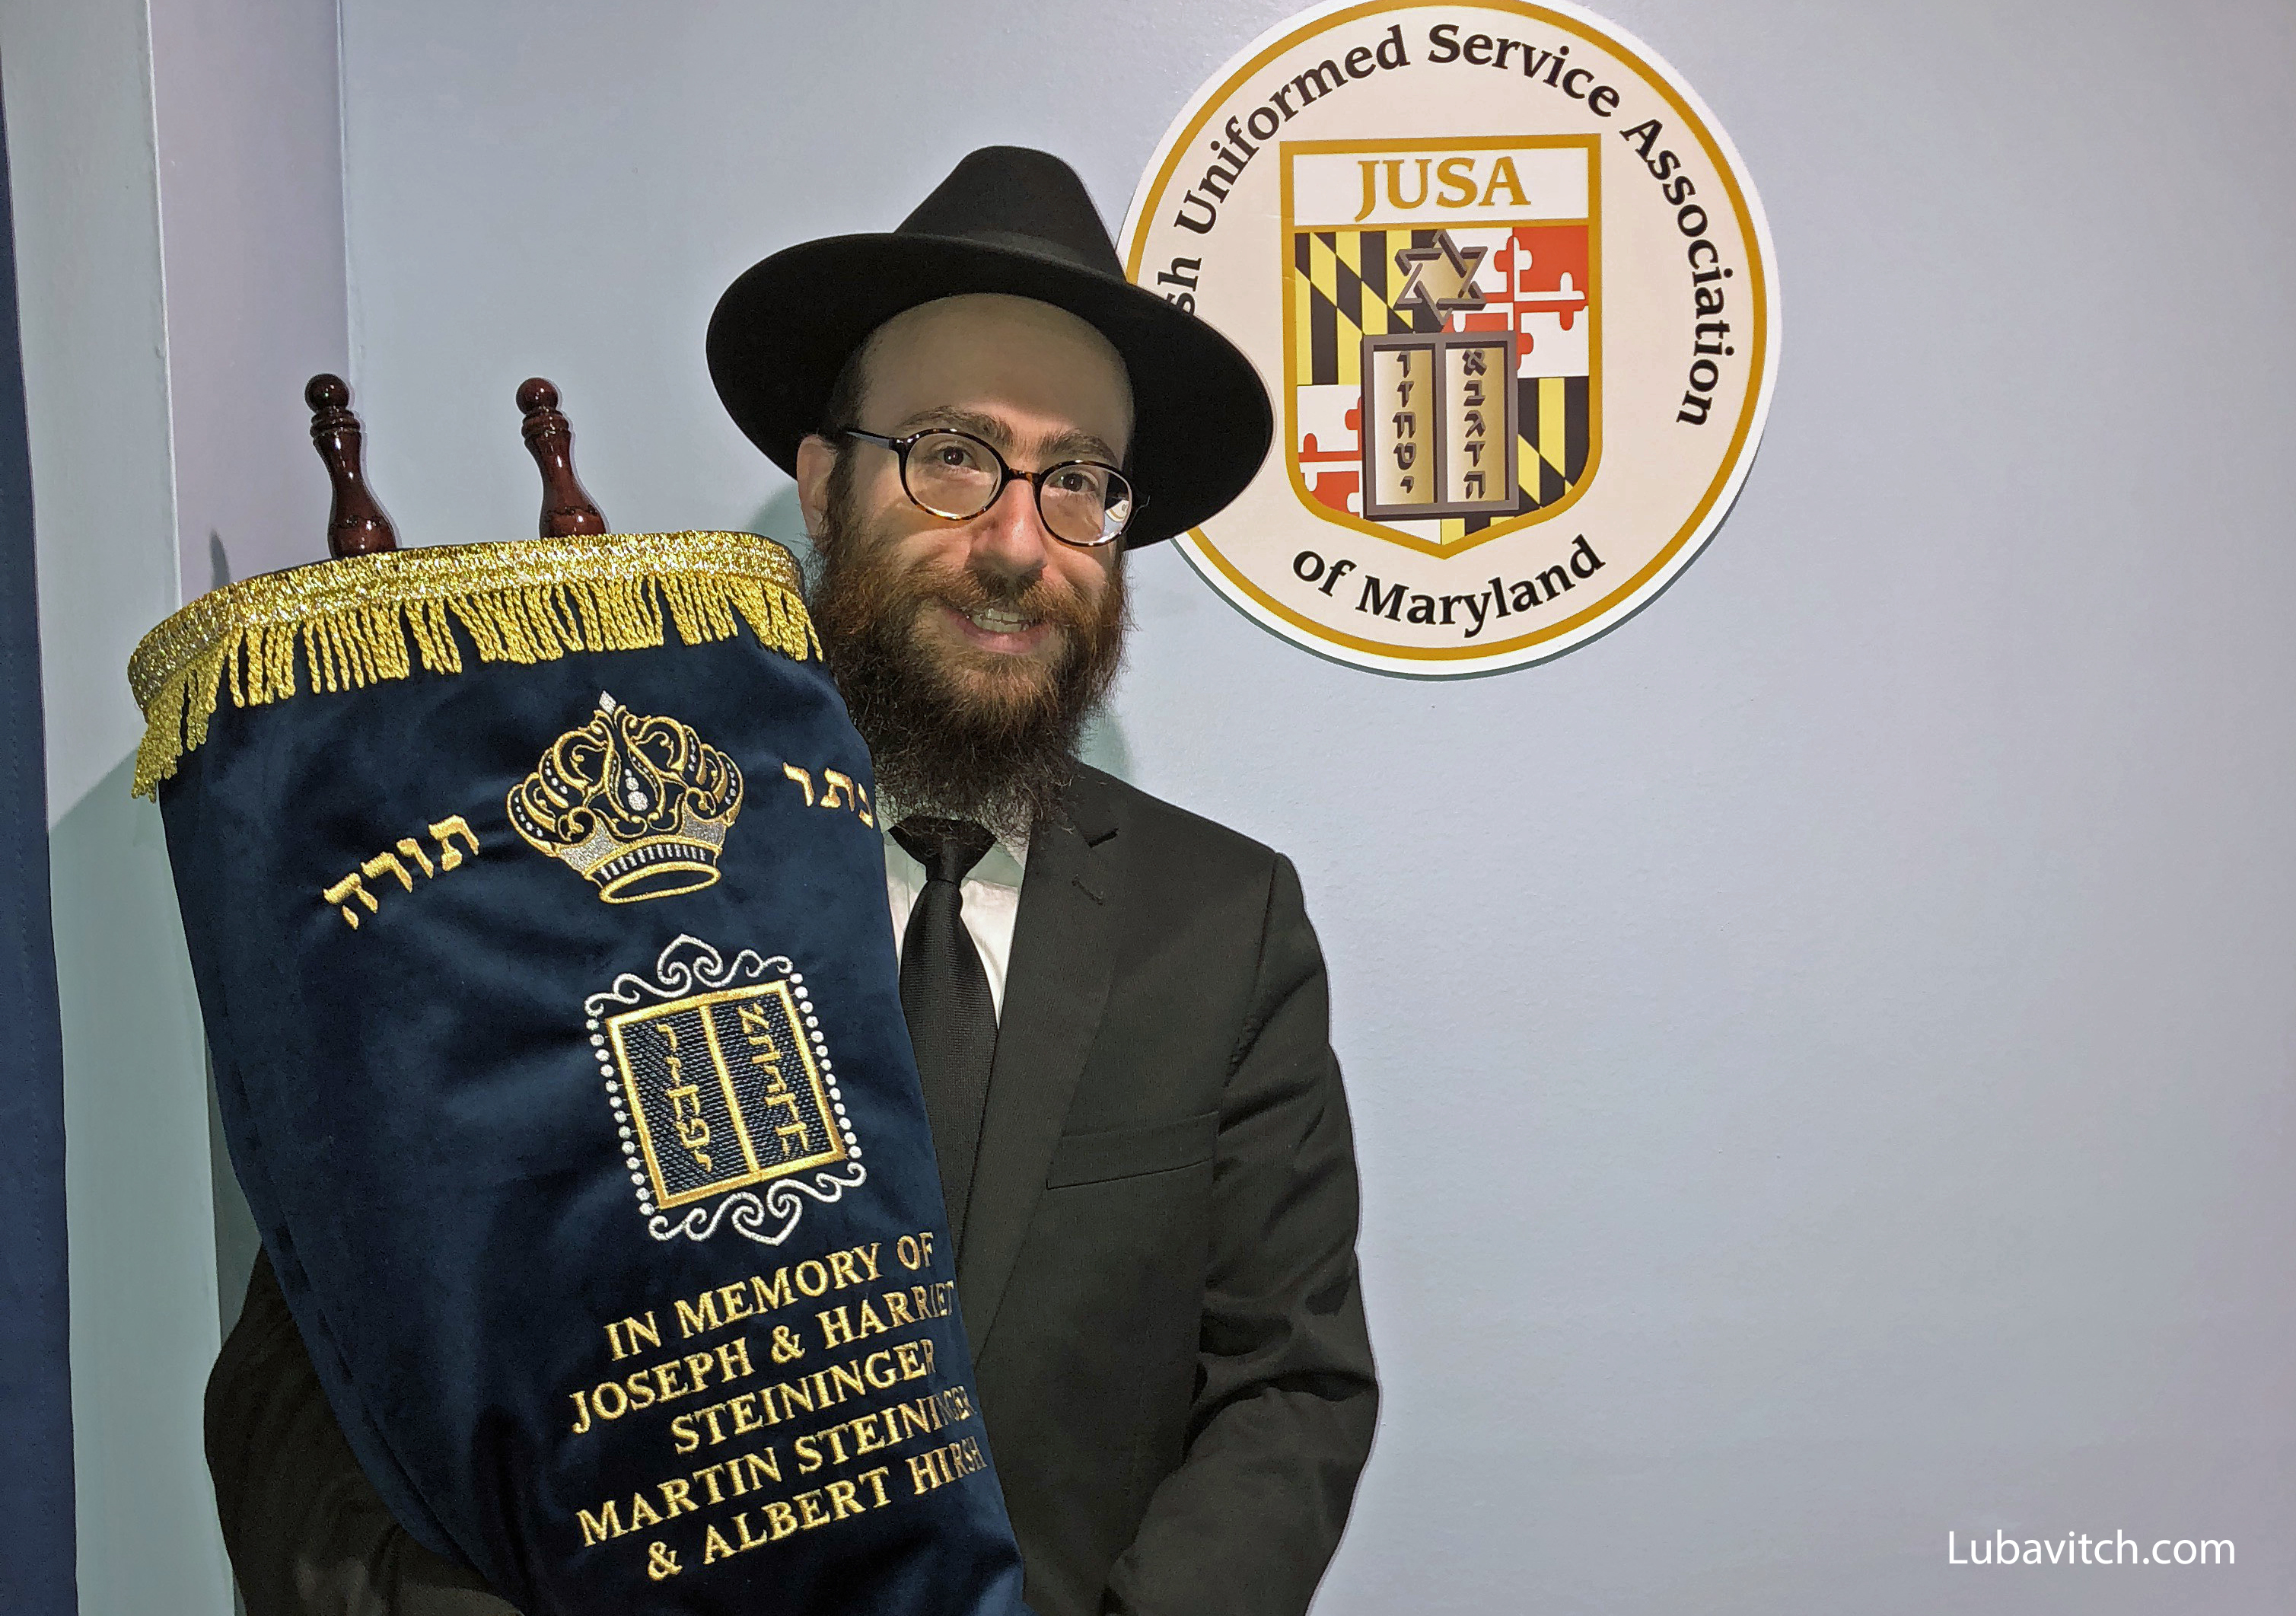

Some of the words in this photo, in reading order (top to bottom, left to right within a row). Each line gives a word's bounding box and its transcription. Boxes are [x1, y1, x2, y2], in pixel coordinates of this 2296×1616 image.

[1175, 24, 1410, 236] Uniformed
[1428, 24, 1619, 116] Service
[1620, 120, 1734, 425] Association
[1355, 157, 1531, 223] JUSA
[1294, 551, 1354, 597] of
[1355, 534, 1606, 637] Maryland
[323, 814, 479, 929] תורה
[569, 1337, 753, 1435] JOSEPH
[772, 1326, 804, 1363] &
[816, 1280, 954, 1350] HARRIET
[606, 1311, 661, 1360] IN
[674, 1243, 880, 1338] MEMORY
[897, 1232, 935, 1270] OF
[670, 1338, 935, 1455] STEININGER
[577, 1448, 781, 1547] MARTIN
[794, 1385, 976, 1475] STEININGER
[648, 1541, 682, 1580] &
[704, 1467, 889, 1564] ALBERT
[905, 1436, 987, 1495] HIRSH
